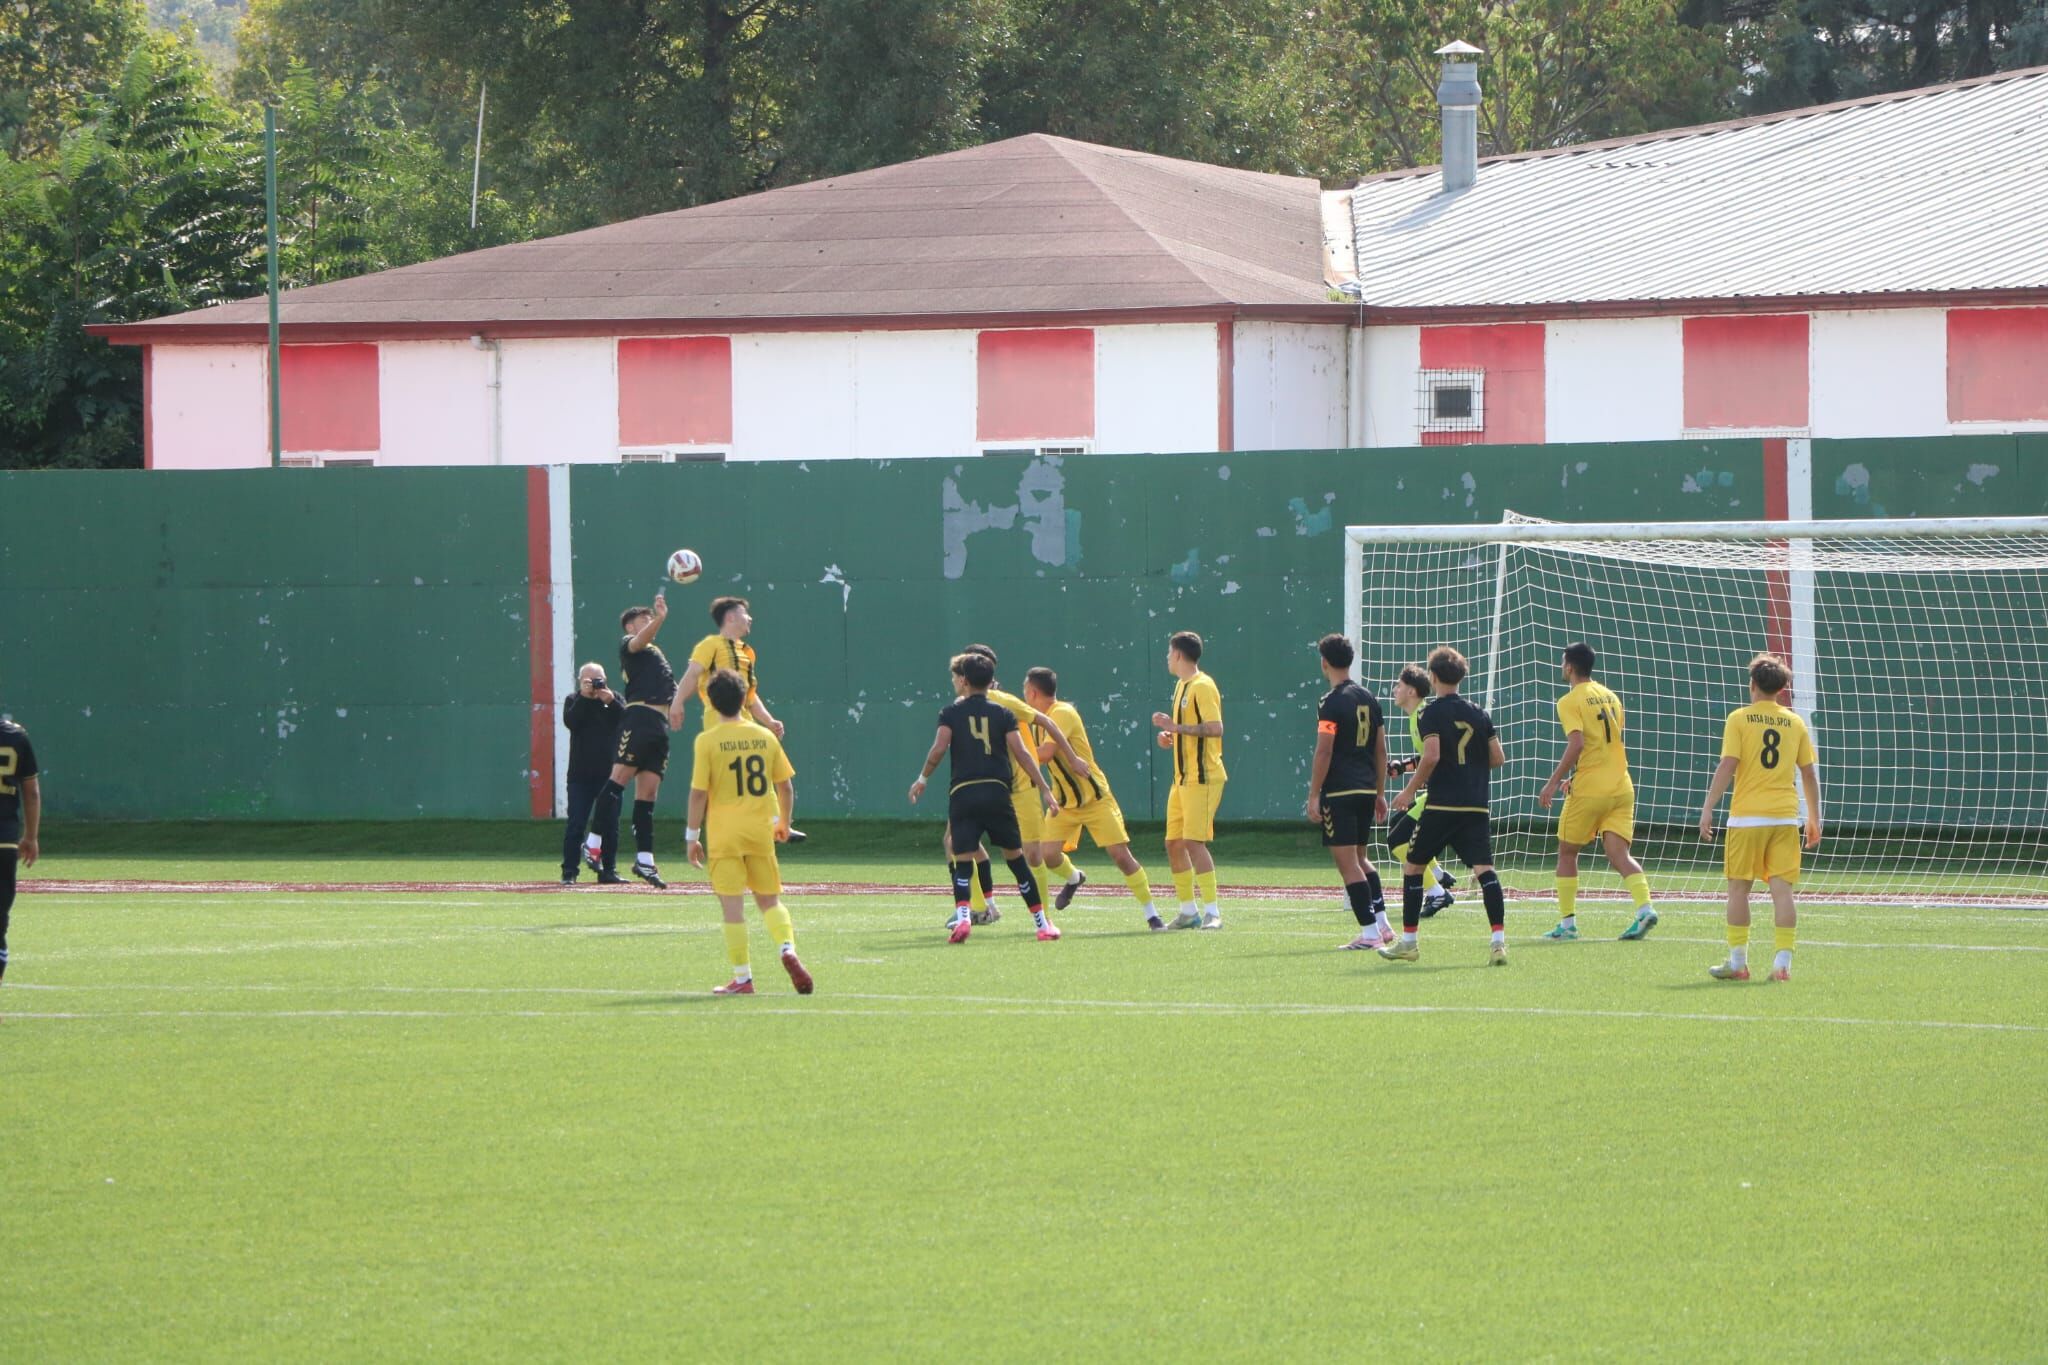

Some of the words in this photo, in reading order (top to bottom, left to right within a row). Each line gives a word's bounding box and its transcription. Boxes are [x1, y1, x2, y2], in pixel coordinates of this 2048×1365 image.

[968, 715, 992, 755] 4
[1746, 714, 1763, 723] FATSA
[1777, 717, 1792, 728] SPOR
[720, 741, 737, 752] FATSA
[752, 739, 767, 750] SPOR
[1454, 720, 1474, 765] 7
[1760, 728, 1780, 769] 8
[729, 755, 767, 796] 18
